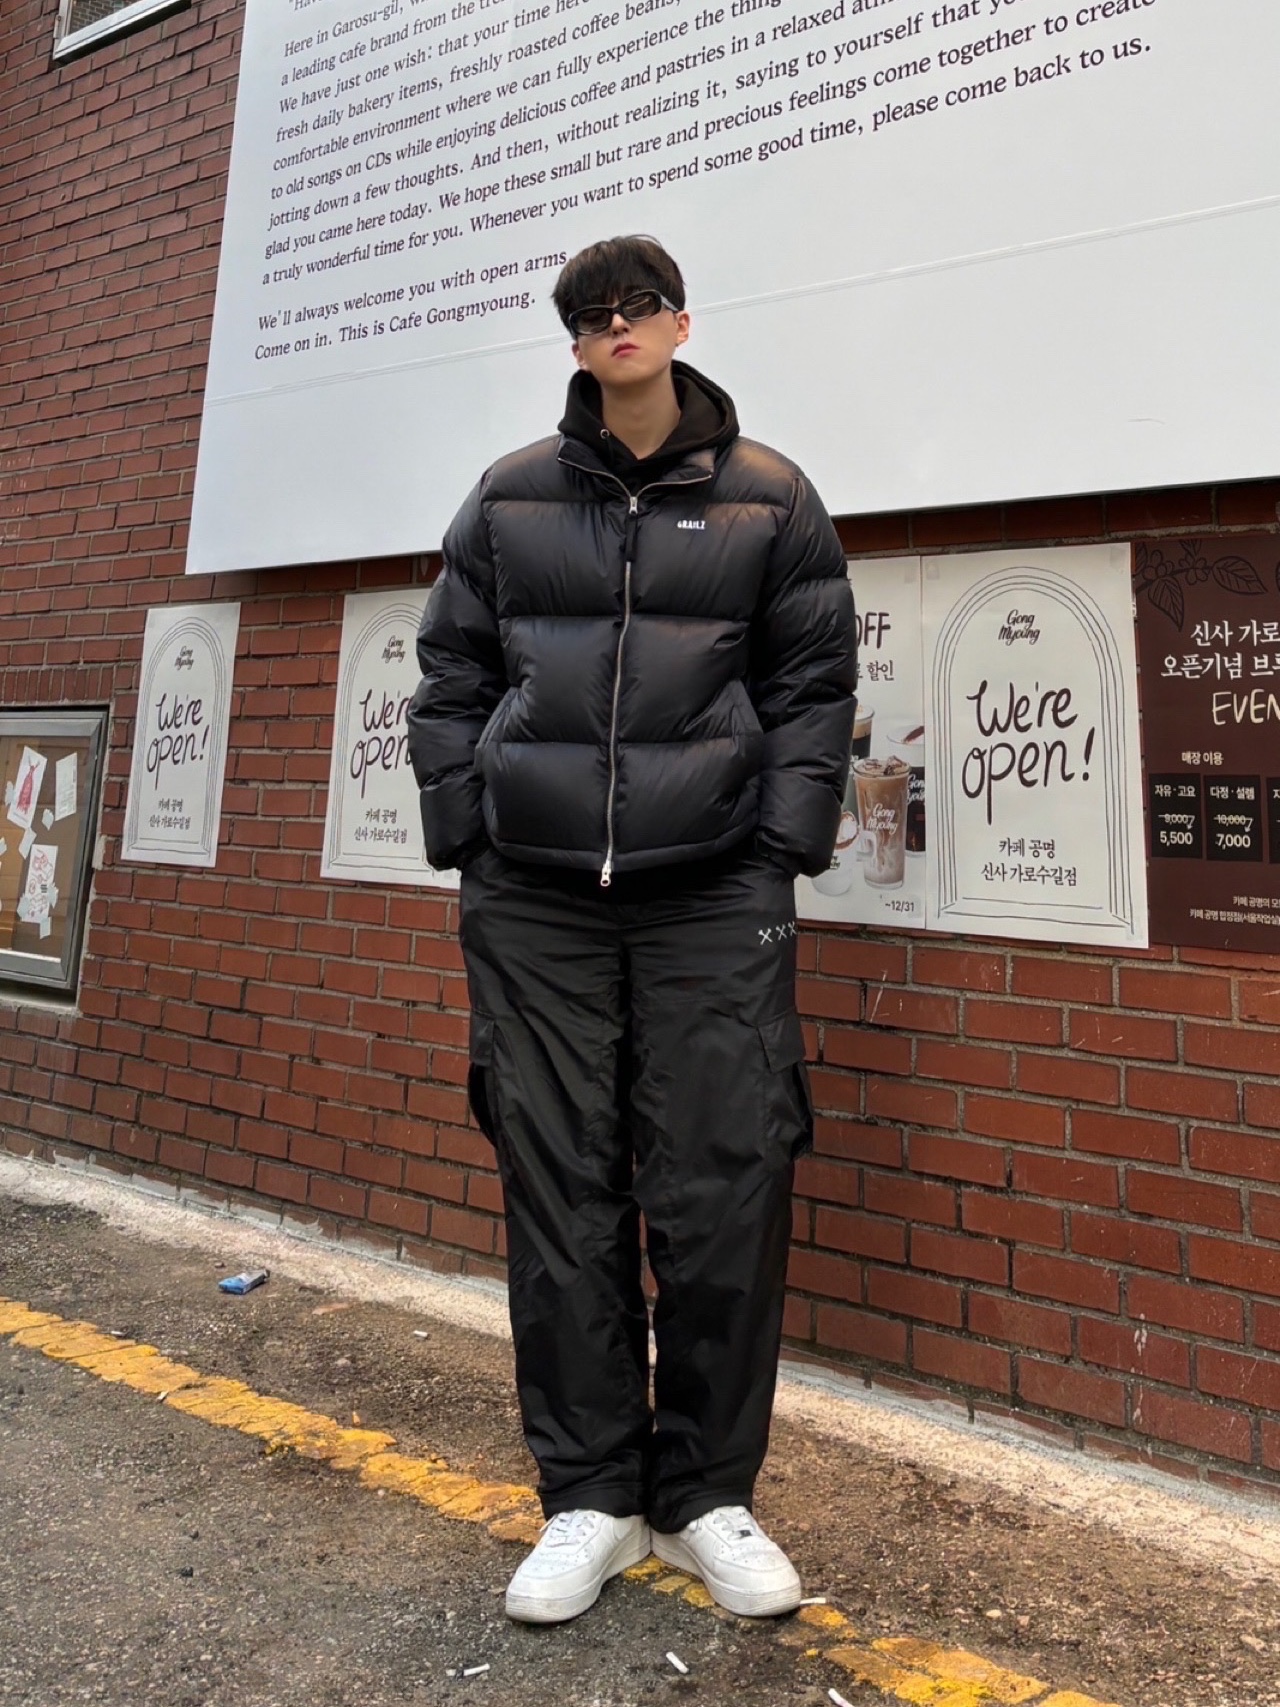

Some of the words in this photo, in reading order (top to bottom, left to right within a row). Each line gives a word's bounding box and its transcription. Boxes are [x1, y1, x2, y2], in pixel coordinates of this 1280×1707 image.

[281, 74, 289, 87] a
[291, 55, 337, 83] leading
[338, 41, 367, 64] cafe
[370, 22, 409, 53] brand
[412, 12, 447, 36] from
[451, 1, 476, 21] the
[284, 36, 314, 58] Here
[315, 29, 329, 45] in
[331, 0, 404, 38] Garosu-gil,
[276, 119, 309, 143] fresh
[312, 108, 345, 131] daily
[347, 91, 395, 119] bakery
[398, 76, 444, 101] items,
[449, 52, 504, 84] freshly
[507, 26, 567, 63] roasted
[571, 12, 620, 41] coffee
[279, 96, 299, 114] We
[300, 85, 332, 107] have
[333, 73, 362, 99] just
[364, 64, 390, 84] one
[393, 45, 433, 73] wish:
[437, 33, 470, 57] that
[473, 19, 510, 48] your
[513, 4, 551, 29] time
[271, 186, 284, 200] to
[285, 175, 305, 196] old
[306, 168, 343, 189] songs
[345, 161, 362, 177] on
[365, 151, 392, 171] CDs
[395, 137, 433, 161] while
[435, 119, 497, 150] enjoying
[499, 98, 567, 130] delicious
[570, 80, 618, 108] coffee
[620, 63, 652, 92] and
[655, 44, 726, 85] pastries
[730, 35, 750, 56] in
[754, 31, 766, 48] a
[771, 0, 846, 42] relaxed
[272, 135, 350, 172] comfortable
[352, 104, 442, 146] environment
[445, 90, 492, 115] where
[495, 80, 518, 99] we
[522, 69, 552, 91] can
[556, 54, 593, 80] fully
[596, 20, 690, 66] experience
[694, 8, 725, 31] the
[264, 235, 291, 260] glad
[292, 233, 316, 254] you
[319, 222, 353, 242] came
[356, 214, 386, 232] here
[390, 203, 432, 223] today.
[438, 191, 462, 210] We
[463, 182, 501, 204] hope
[503, 170, 547, 193] these
[549, 152, 591, 181] small
[595, 146, 624, 168] but
[626, 136, 662, 159] rare
[665, 119, 700, 148] and
[703, 100, 783, 141] precious
[788, 75, 868, 112] feelings
[872, 56, 932, 87] come
[937, 24, 1037, 68] together
[1043, 14, 1069, 36] to
[266, 205, 311, 232] jotting
[313, 194, 349, 216] down
[352, 191, 361, 205] a
[364, 182, 391, 201] few
[394, 162, 464, 193] thoughts.
[469, 145, 501, 171] And
[505, 138, 549, 160] then,
[556, 112, 620, 145] without
[624, 88, 700, 125] realizing
[706, 79, 727, 100] it,
[735, 57, 800, 91] saying
[805, 49, 828, 69] to
[833, 11, 925, 65] yourself
[931, 0, 981, 29] that
[262, 273, 270, 286] a
[272, 262, 304, 283] truly
[305, 243, 371, 274] wonderful
[373, 238, 405, 257] time
[407, 231, 430, 249] for
[431, 224, 464, 247] you.
[469, 202, 547, 233] Whenever
[550, 194, 579, 218] you
[582, 180, 624, 205] want
[627, 176, 645, 193] to
[648, 155, 700, 190] spend
[703, 146, 753, 172] some
[757, 127, 804, 162] good
[809, 118, 864, 144] time,
[872, 94, 939, 133] please
[944, 75, 1008, 107] come
[1013, 53, 1072, 88] back
[1078, 48, 1105, 70] to
[1111, 37, 1152, 61] us.
[258, 310, 291, 330] We'll
[294, 303, 339, 320] always
[343, 288, 405, 312] welcome
[408, 280, 435, 301] you
[440, 267, 476, 291] with
[479, 261, 519, 285] open
[524, 250, 567, 272] arms
[254, 342, 291, 360] Come
[293, 338, 311, 353] on
[314, 332, 332, 348] in.
[338, 322, 369, 343] This
[372, 319, 385, 336] is
[389, 310, 423, 333] Cafe
[426, 291, 536, 325] Gongmyoung.
[1007, 609, 1035, 629] Gong
[1190, 620, 1234, 647] 신사
[866, 660, 895, 681] 할인
[1160, 652, 1243, 680] 오픈기념
[155, 693, 204, 731] We're
[358, 689, 414, 733] We'r
[966, 679, 1079, 737] We're
[146, 724, 210, 791] open!
[961, 726, 1096, 826] open!
[1181, 751, 1201, 766] 매장
[1203, 751, 1224, 766] 이용
[354, 826, 368, 841] 신사
[368, 827, 408, 844] 가로수길점
[365, 807, 381, 823] 카페
[381, 808, 397, 824] 공명
[1159, 830, 1194, 847] 5,500
[998, 837, 1025, 858] 카페
[1028, 839, 1055, 859] 공명
[1216, 833, 1251, 850] 7,000
[981, 862, 1008, 882] 신사
[1009, 863, 1077, 887] 가로수길점
[885, 900, 915, 912] ~12/31
